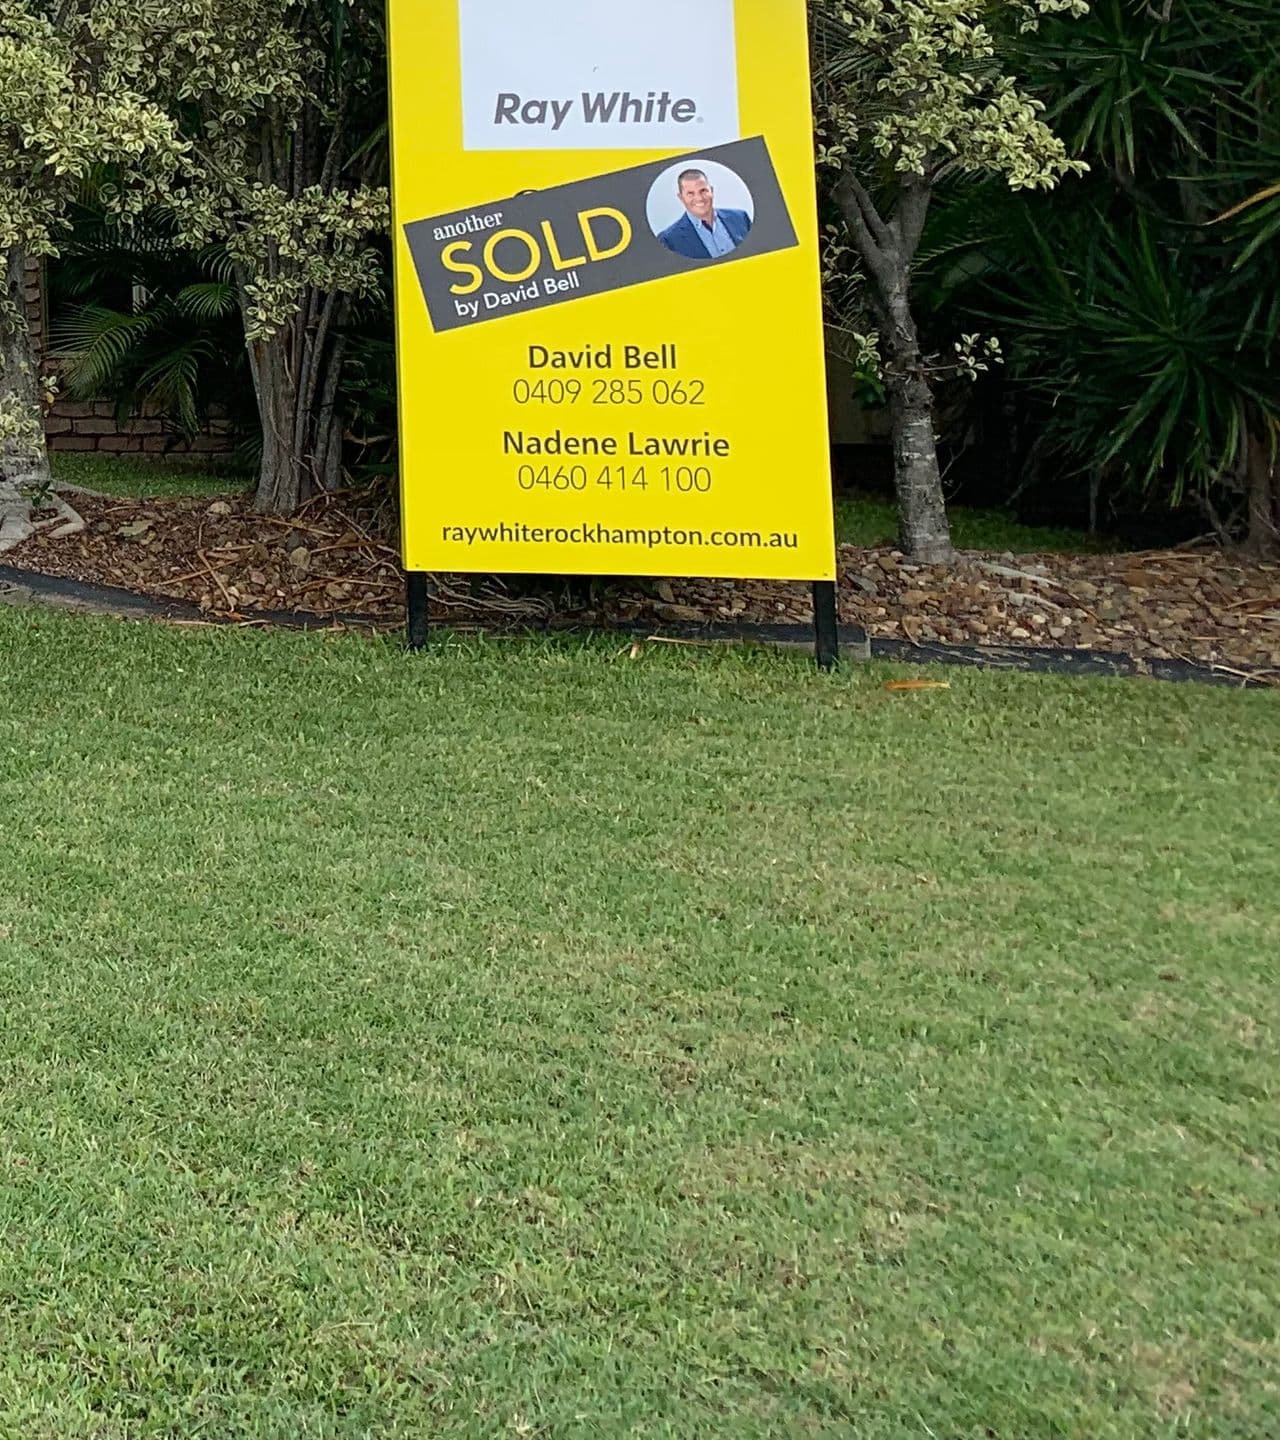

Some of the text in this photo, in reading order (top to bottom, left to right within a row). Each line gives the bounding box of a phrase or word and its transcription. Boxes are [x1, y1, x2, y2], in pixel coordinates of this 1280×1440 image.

[494, 92, 697, 131] Ray White
[433, 212, 503, 241] another
[441, 207, 632, 295] SOLD
[454, 271, 580, 318] by David Bell
[528, 343, 677, 370] David Bell
[513, 378, 706, 405] 0409 285 062
[503, 429, 730, 458] Nadene Lawrie
[518, 464, 712, 493] 0460 414 100
[442, 521, 798, 549] raywhiterockhampton.com.au
